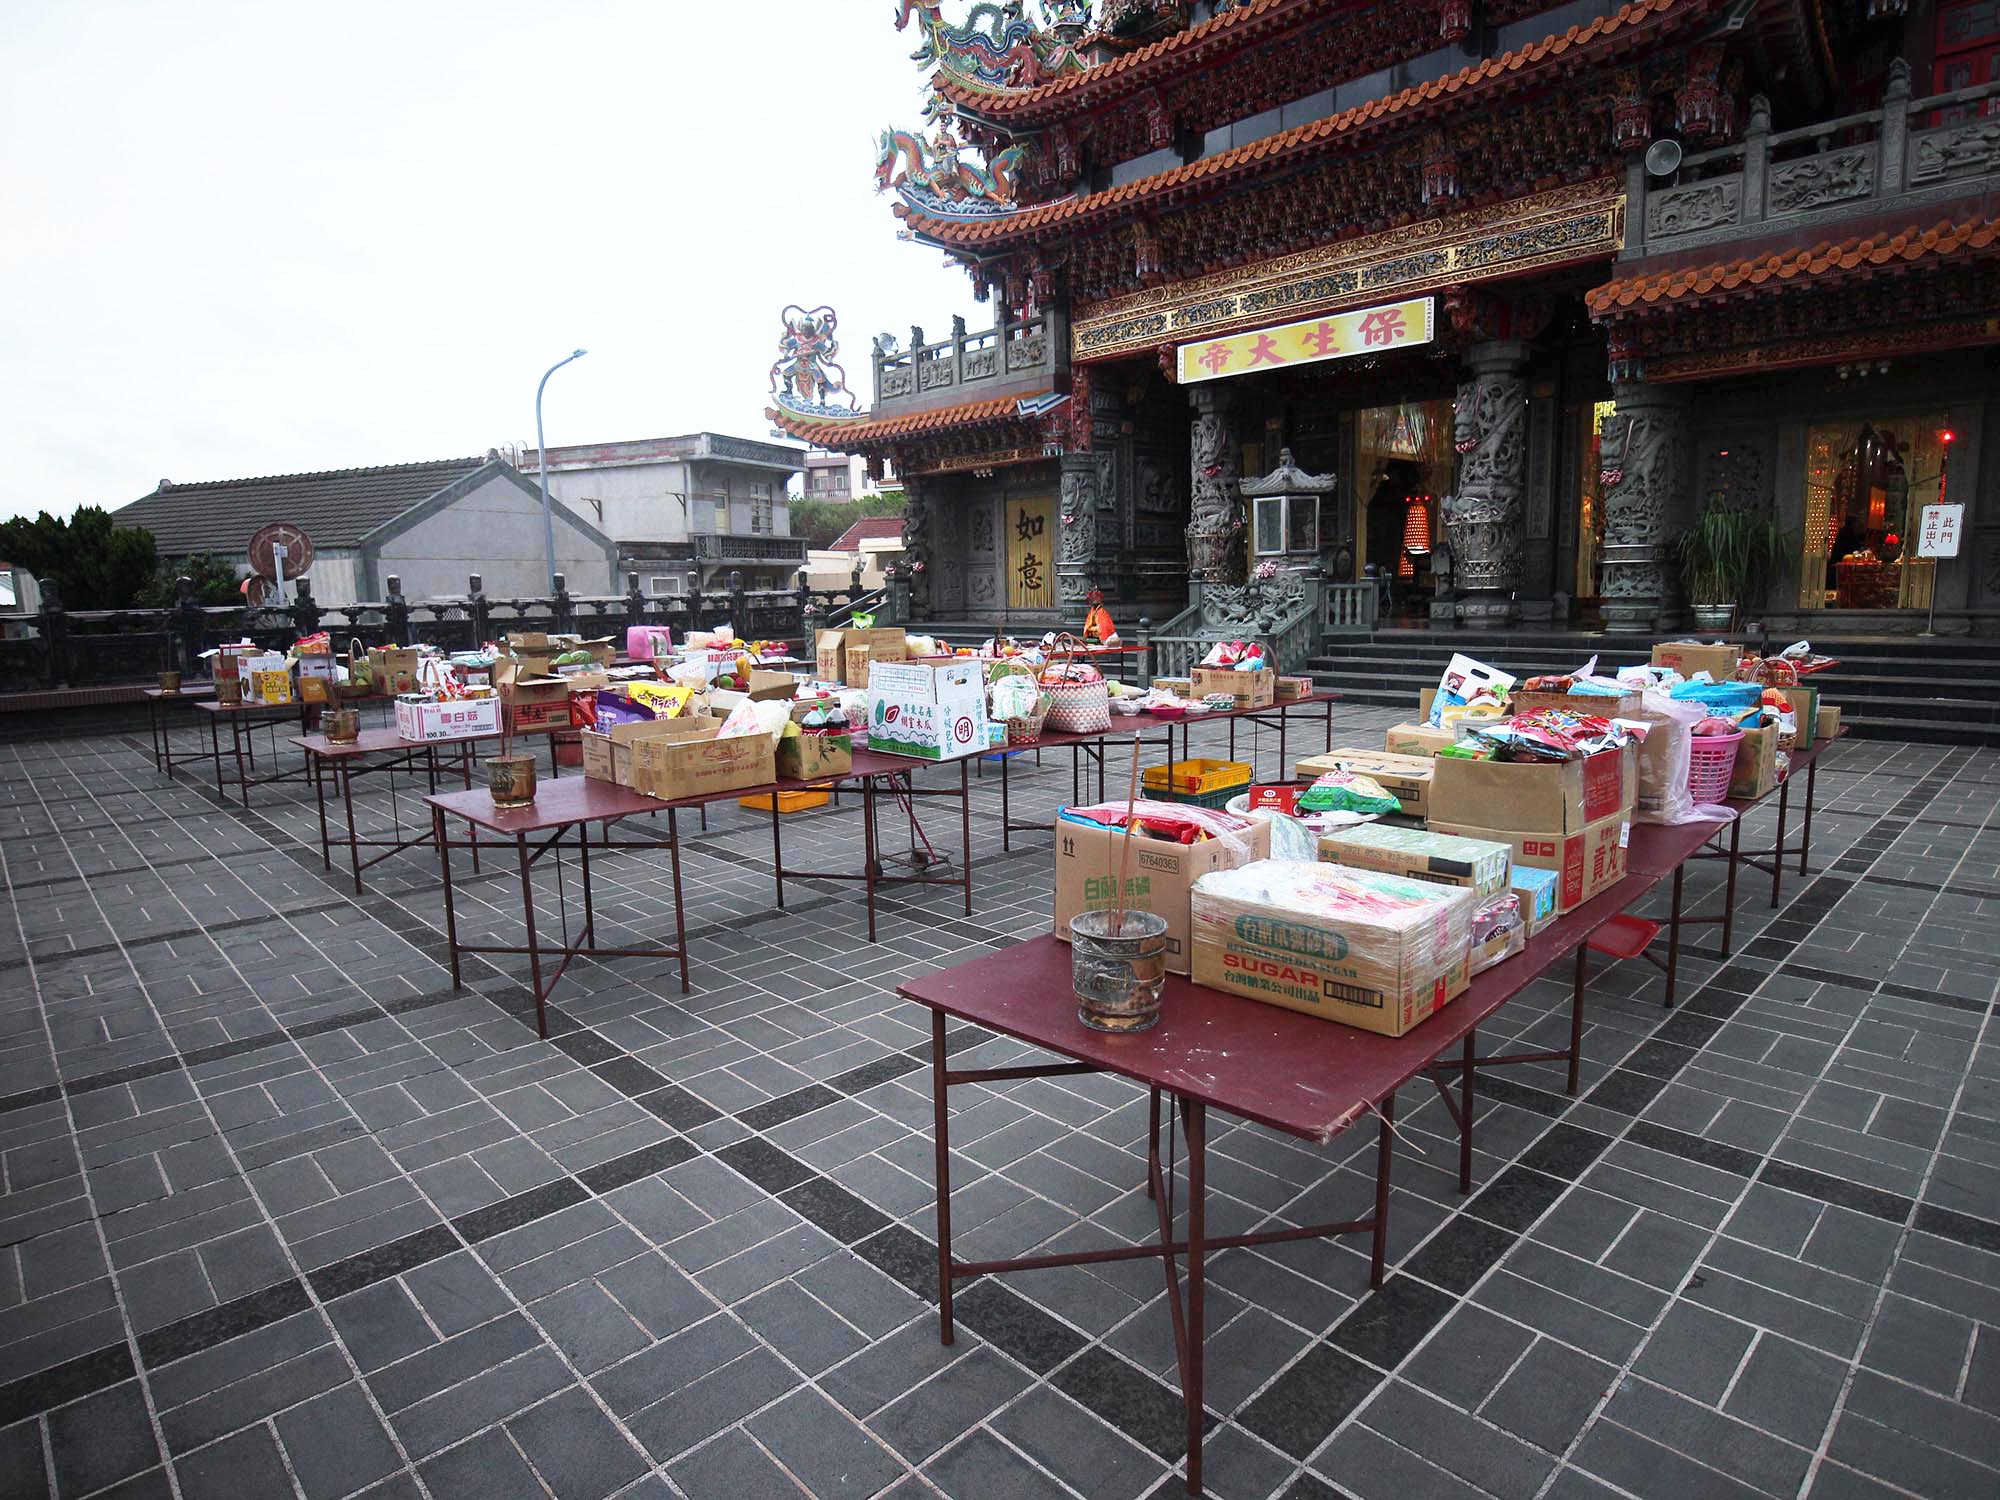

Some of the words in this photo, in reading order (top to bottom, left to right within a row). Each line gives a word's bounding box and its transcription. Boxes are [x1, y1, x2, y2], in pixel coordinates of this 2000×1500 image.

[1198, 308, 1407, 376] 保生大帝
[1015, 507, 1045, 590] 如意
[1923, 511, 1940, 549] 禁止出入
[1940, 516, 1954, 544] 此門
[1140, 854, 1178, 871] 67640363
[1591, 840, 1619, 884] 貢丸
[1223, 953, 1320, 987] SUGAR
